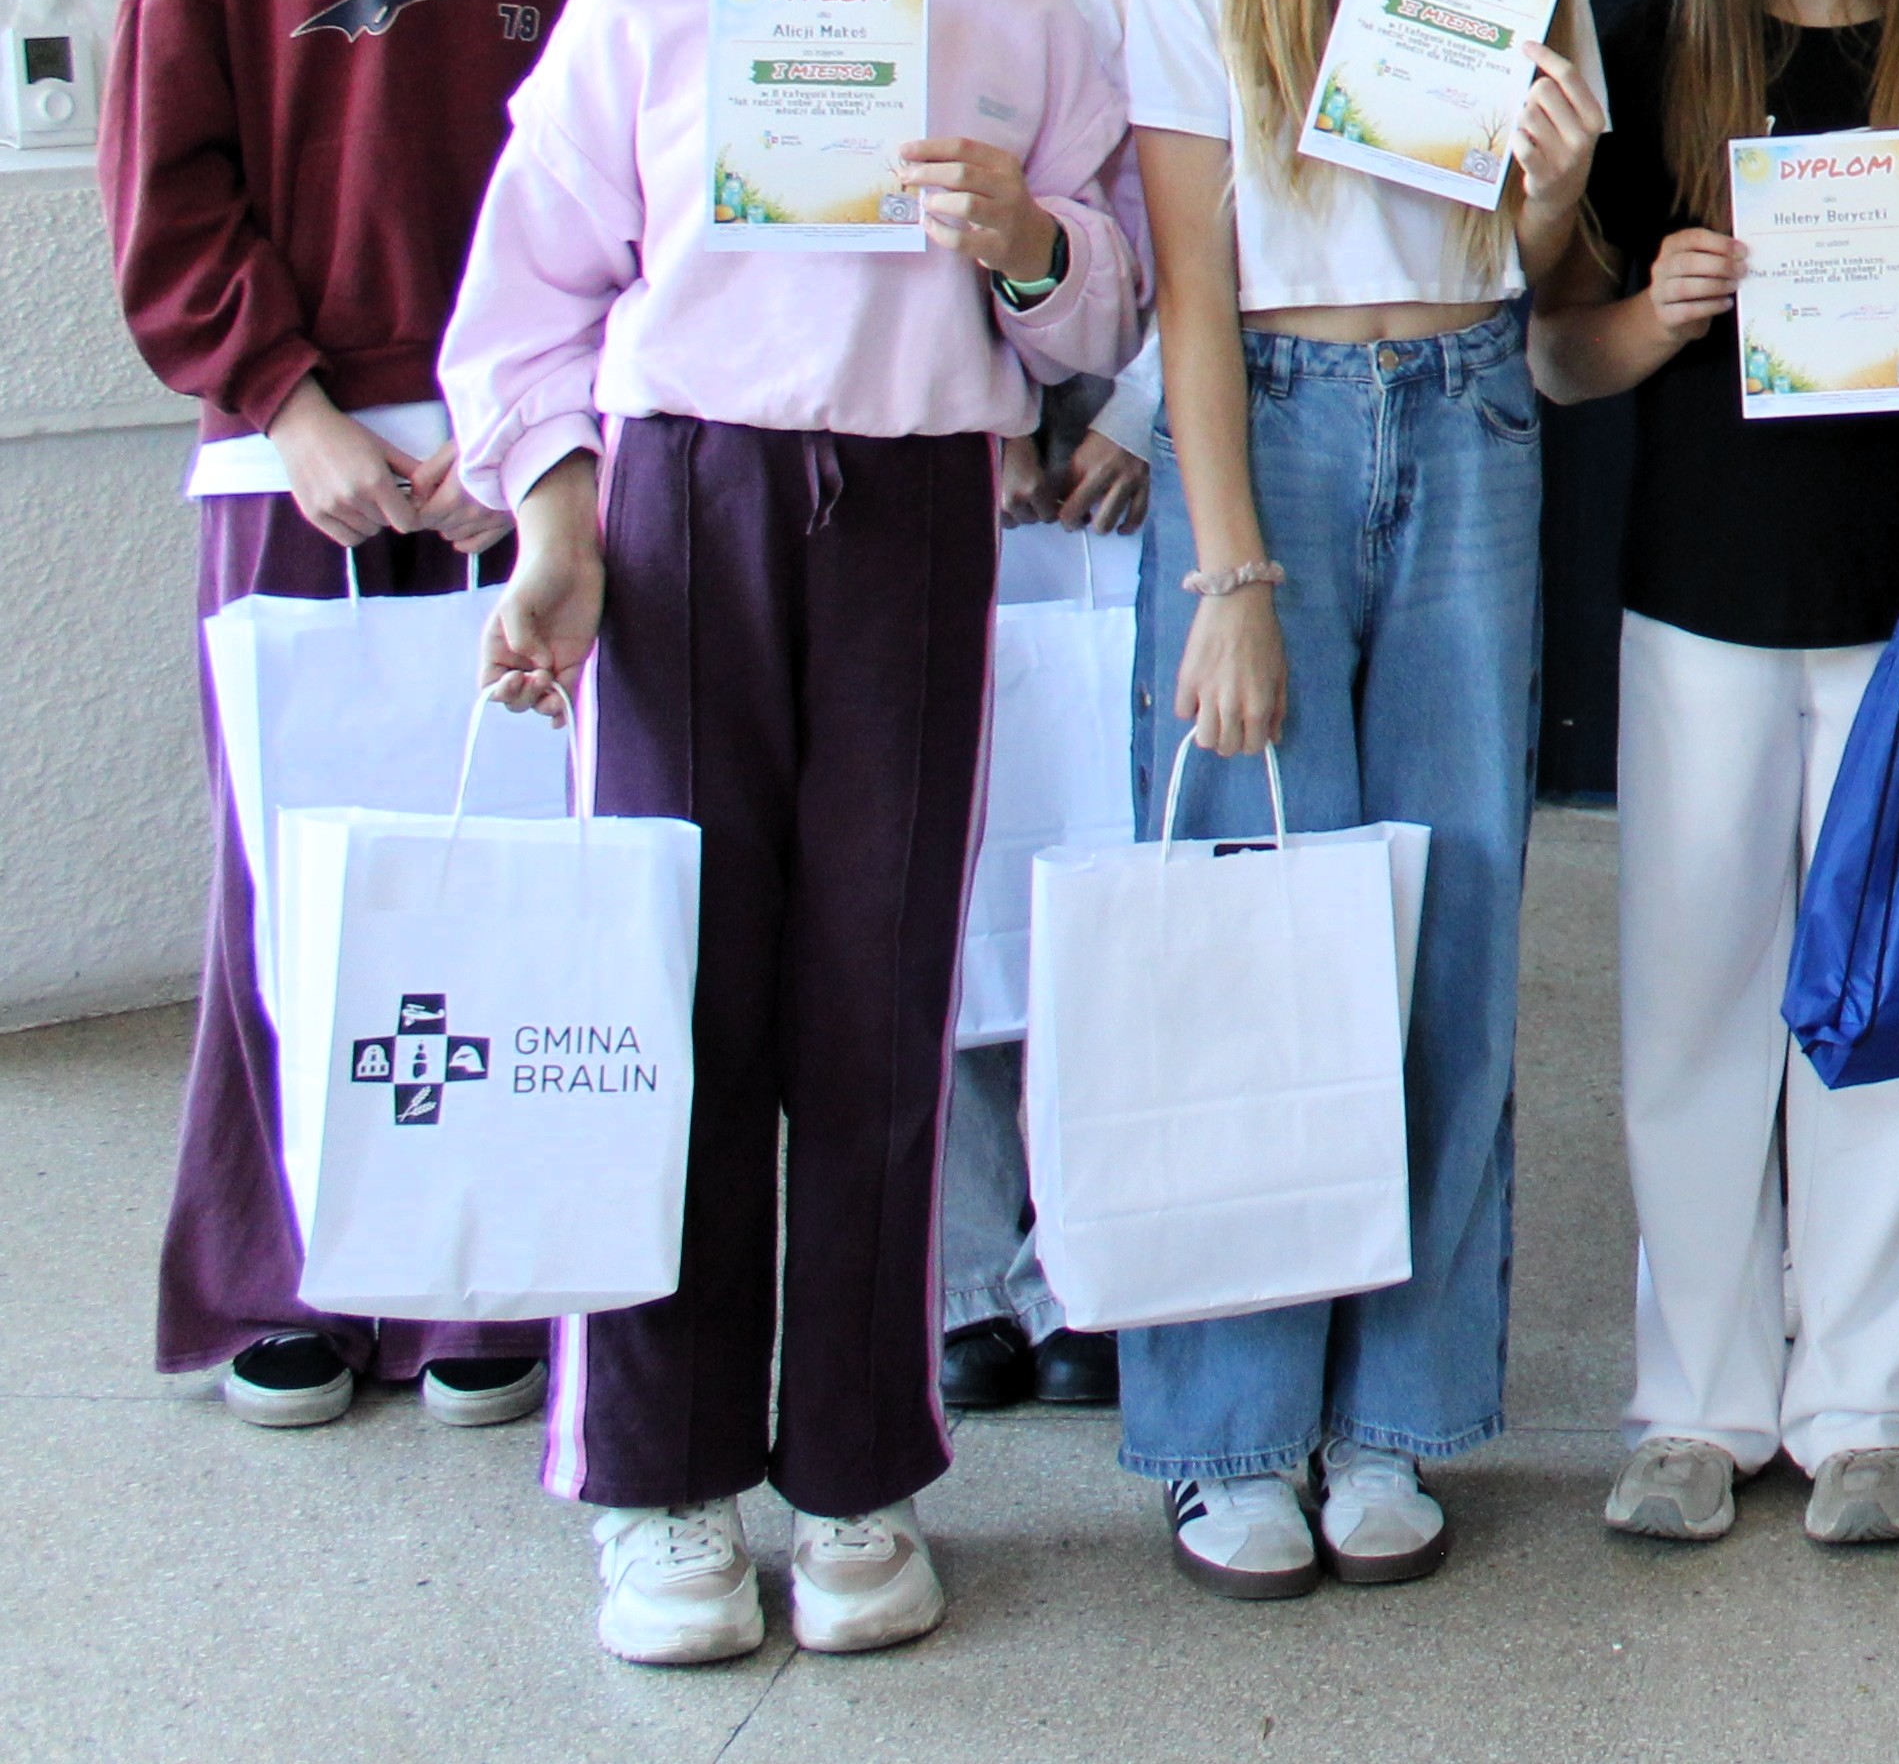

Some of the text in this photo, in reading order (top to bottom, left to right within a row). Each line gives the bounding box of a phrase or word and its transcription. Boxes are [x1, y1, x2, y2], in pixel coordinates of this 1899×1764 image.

[773, 24, 814, 39] Alicji
[1421, 6, 1499, 41] MIEJSCA
[774, 64, 874, 80] I MIEJSCA
[1780, 155, 1893, 180] DYPLOM
[1774, 209, 1887, 226] Heleny Boryczki
[515, 1025, 641, 1055] GMINA
[512, 1064, 658, 1094] BRALIN
